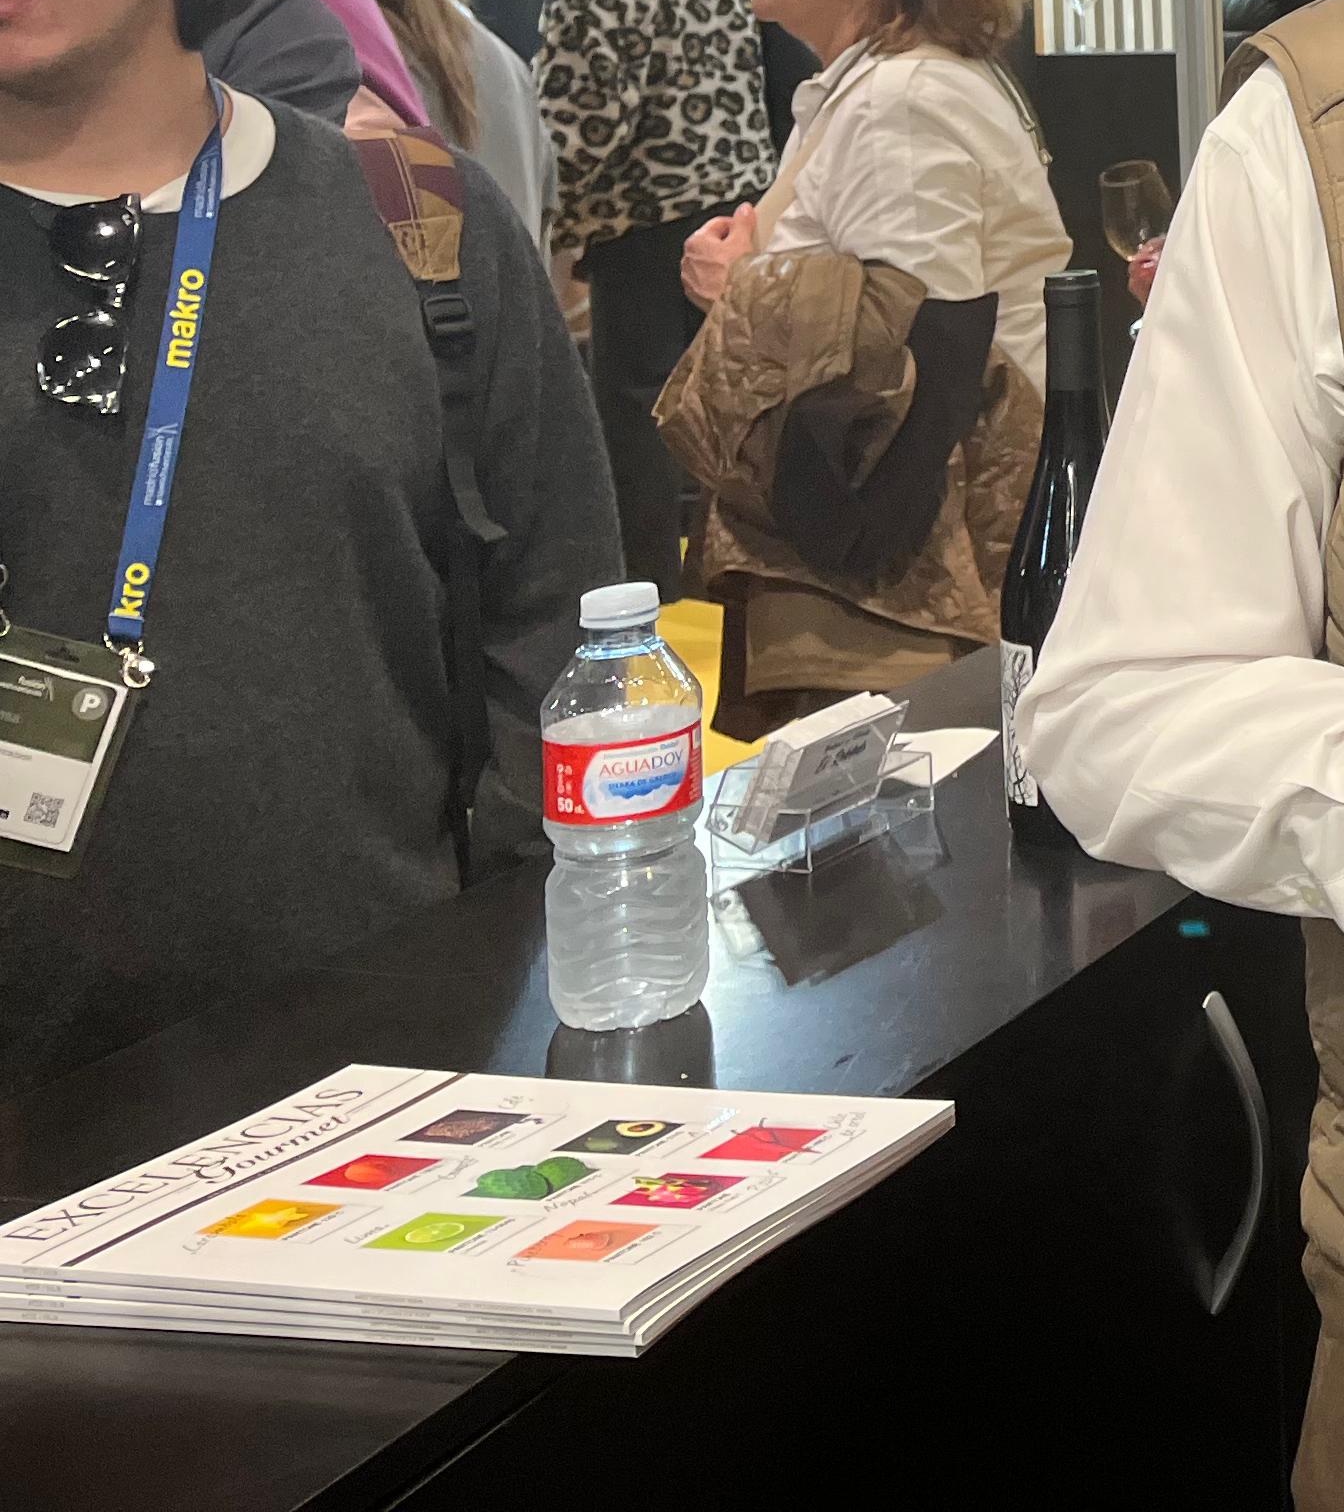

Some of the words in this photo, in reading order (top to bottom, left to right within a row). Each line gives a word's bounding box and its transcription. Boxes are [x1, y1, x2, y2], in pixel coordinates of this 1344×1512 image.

[165, 268, 205, 369] makro
[114, 562, 150, 617] kro
[1, 1088, 363, 1241] EXCELENCIAS
[194, 1113, 350, 1185] Gourmet
